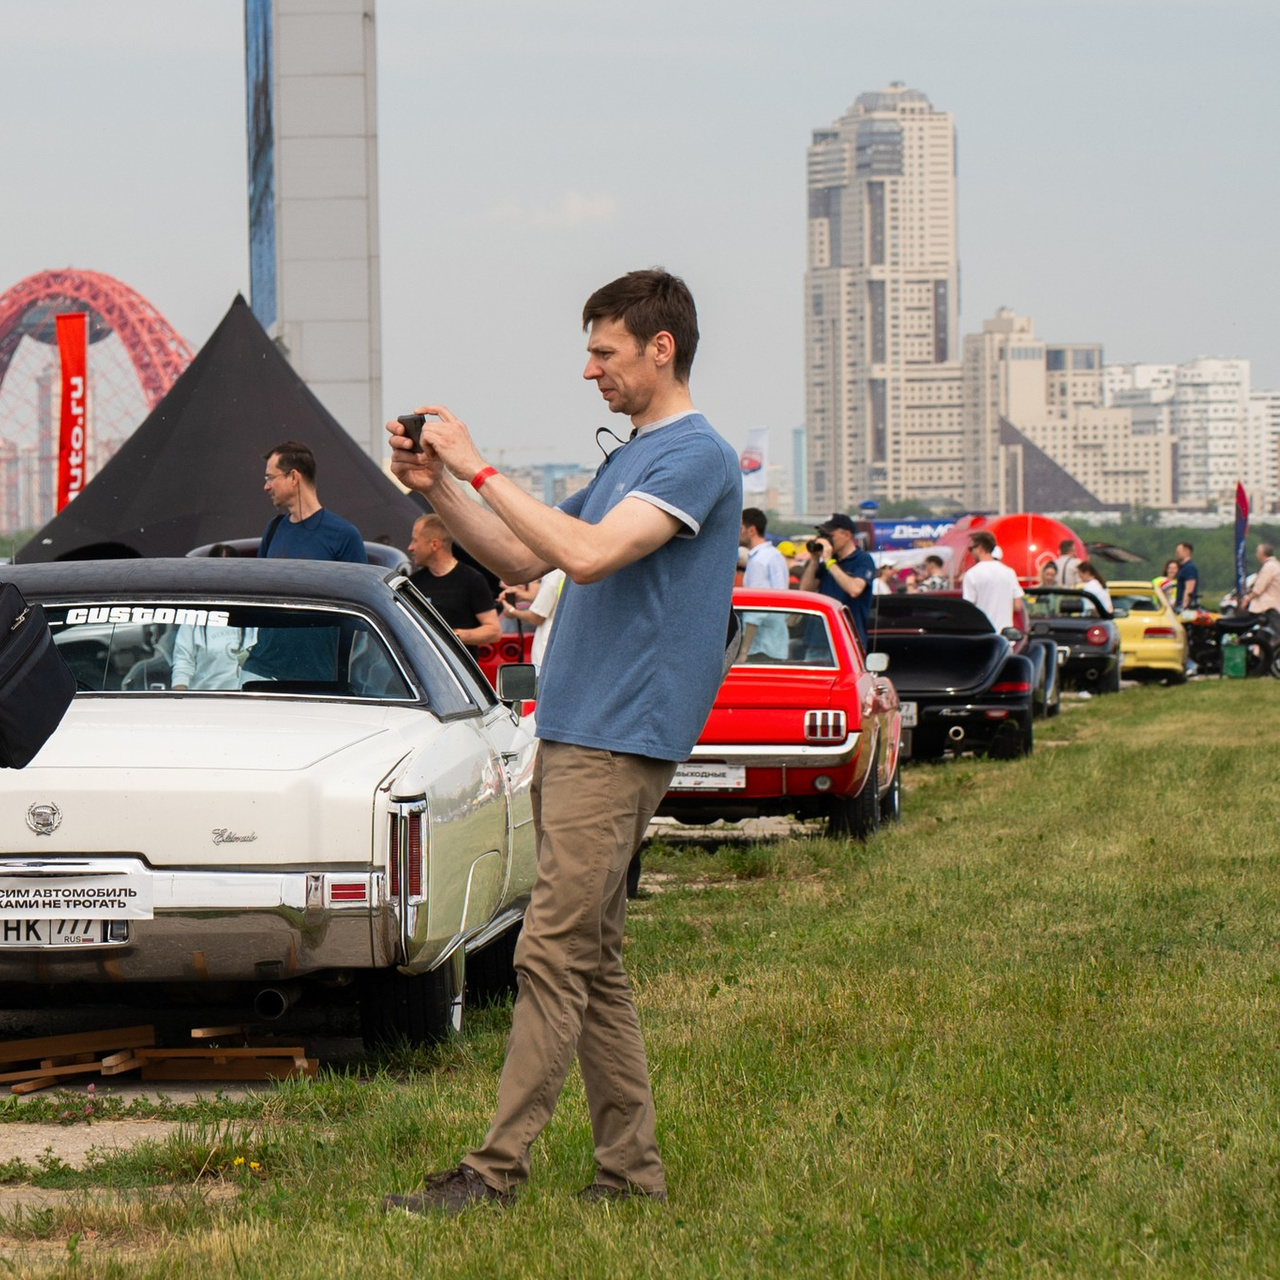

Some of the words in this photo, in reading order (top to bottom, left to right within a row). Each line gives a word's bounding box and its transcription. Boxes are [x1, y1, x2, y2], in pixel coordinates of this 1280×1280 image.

[32, 888, 137, 898] АВТОМОБИЛЬ
[42, 900, 61, 909] НЕ
[64, 899, 127, 908] ТРОГАТЬ
